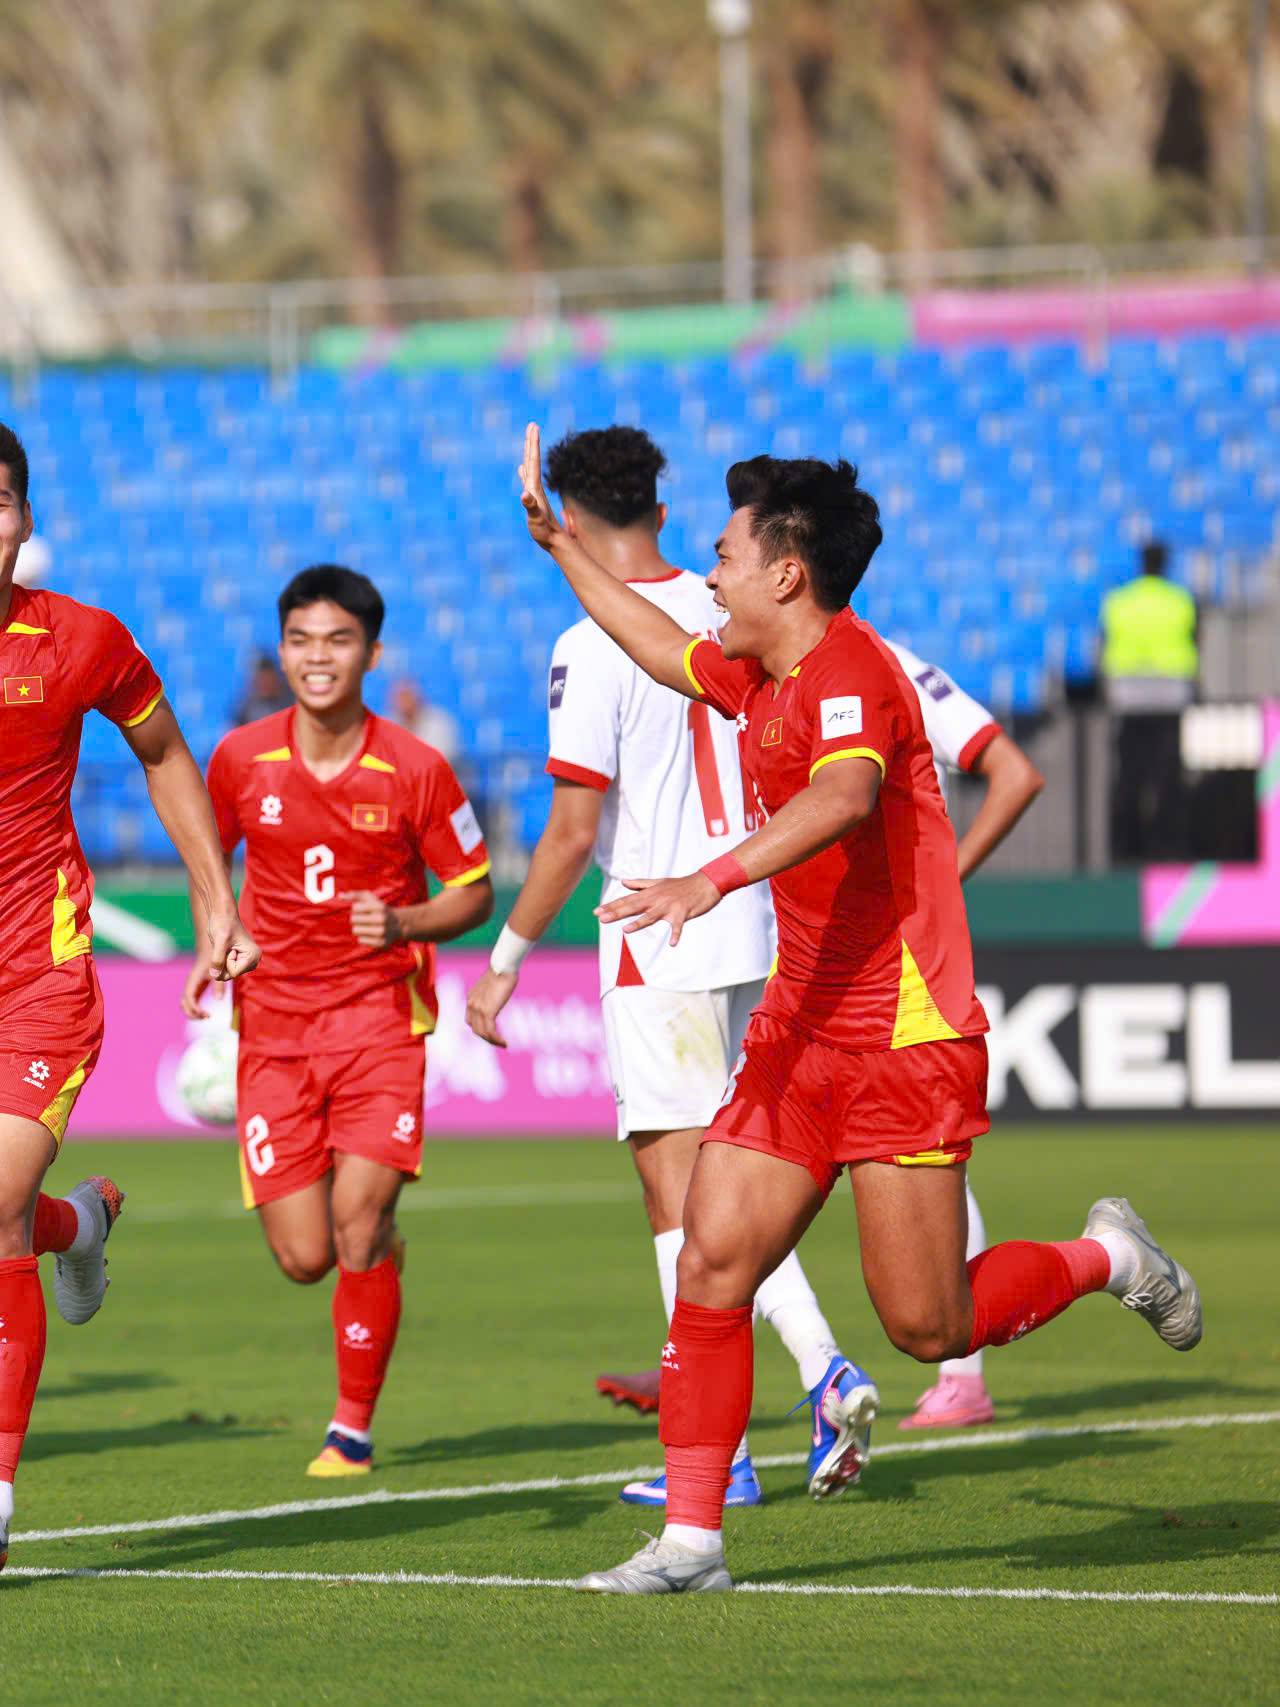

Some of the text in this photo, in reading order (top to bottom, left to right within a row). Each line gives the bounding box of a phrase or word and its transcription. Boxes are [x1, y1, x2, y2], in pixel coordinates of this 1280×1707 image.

[827, 710, 855, 723] AFC
[304, 845, 335, 904] 2
[976, 982, 1280, 1110] KEL
[245, 1114, 275, 1177] 2
